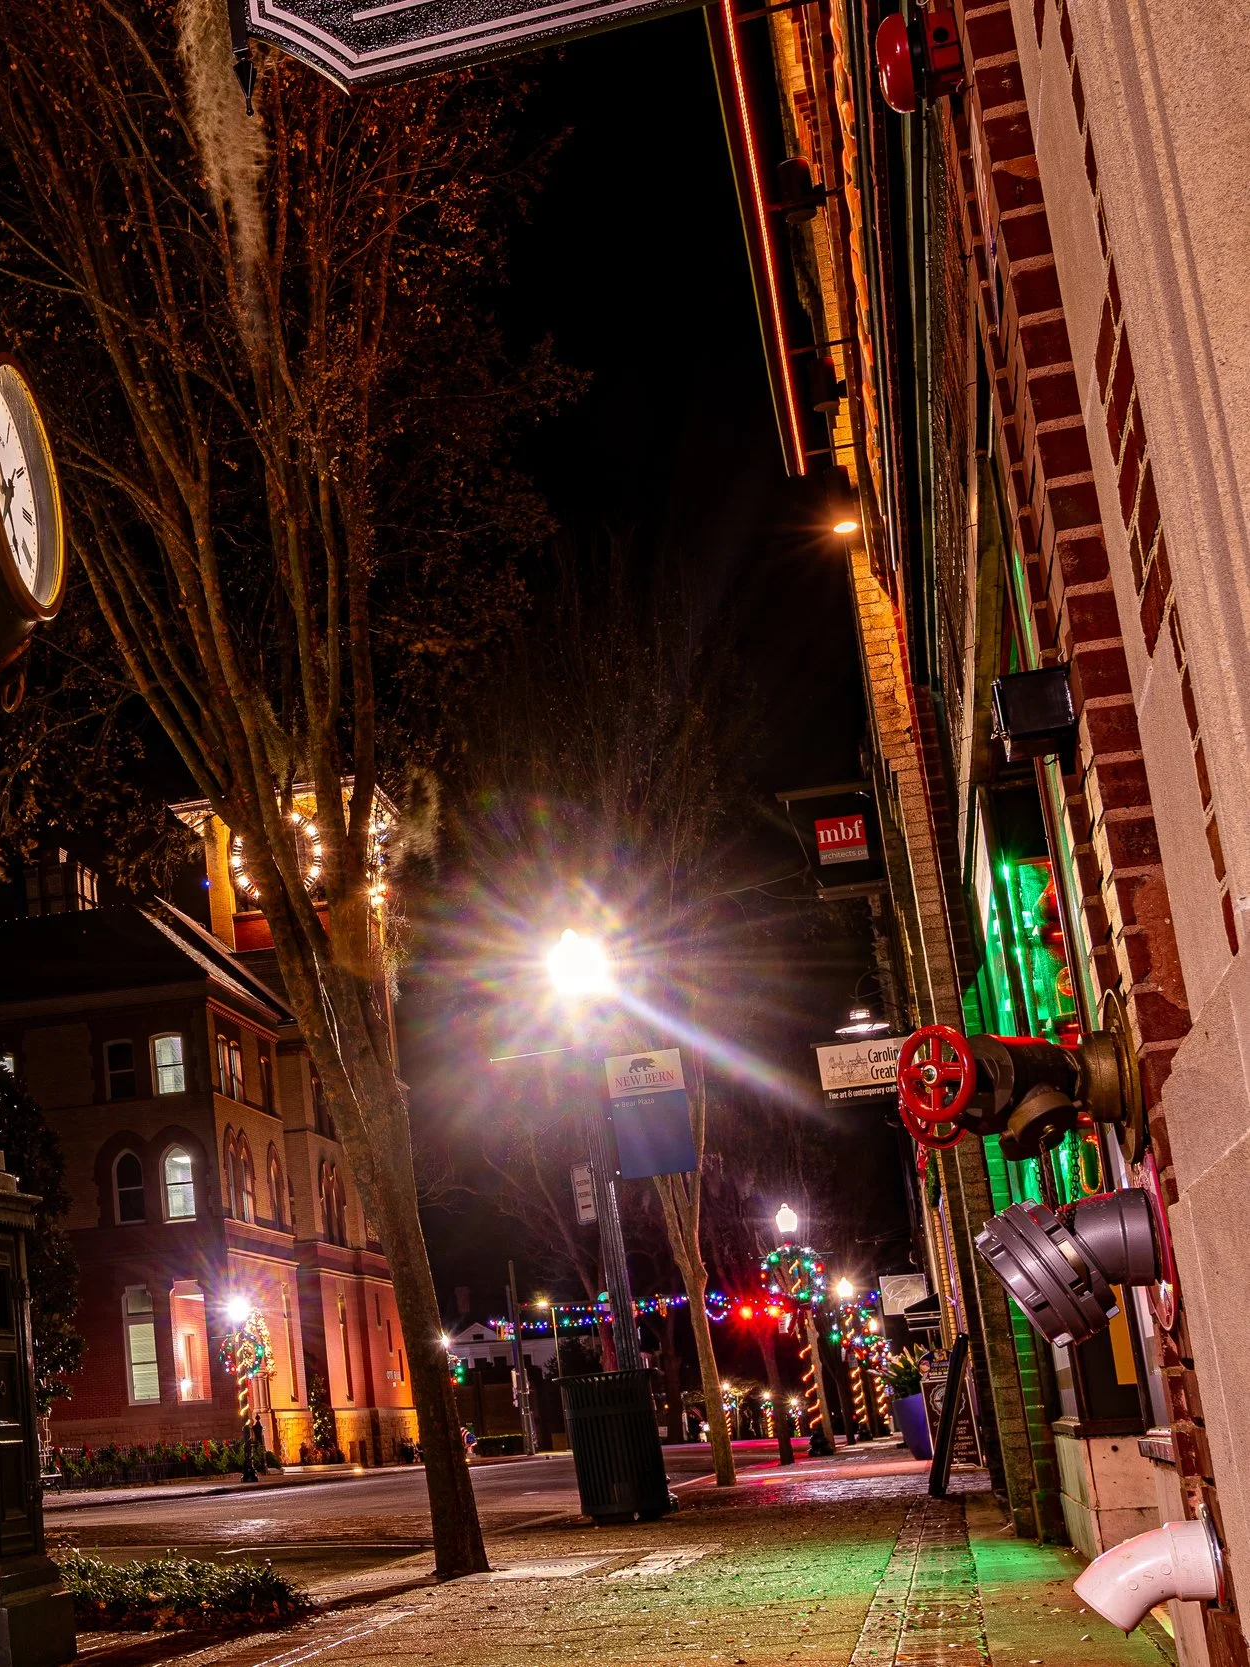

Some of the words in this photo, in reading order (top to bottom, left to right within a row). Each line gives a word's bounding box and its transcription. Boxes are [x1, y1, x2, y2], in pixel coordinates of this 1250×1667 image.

[817, 820, 863, 844] mbf
[821, 850, 857, 861] architects
[868, 1046, 900, 1064] Carolin
[615, 1074, 642, 1088] NEW
[644, 1070, 674, 1084] BERN
[870, 1063, 898, 1080] Creati
[828, 1089, 839, 1100] Fine
[839, 1090, 847, 1098] art
[853, 1086, 885, 1097] contemporary
[886, 1084, 899, 1093] craft
